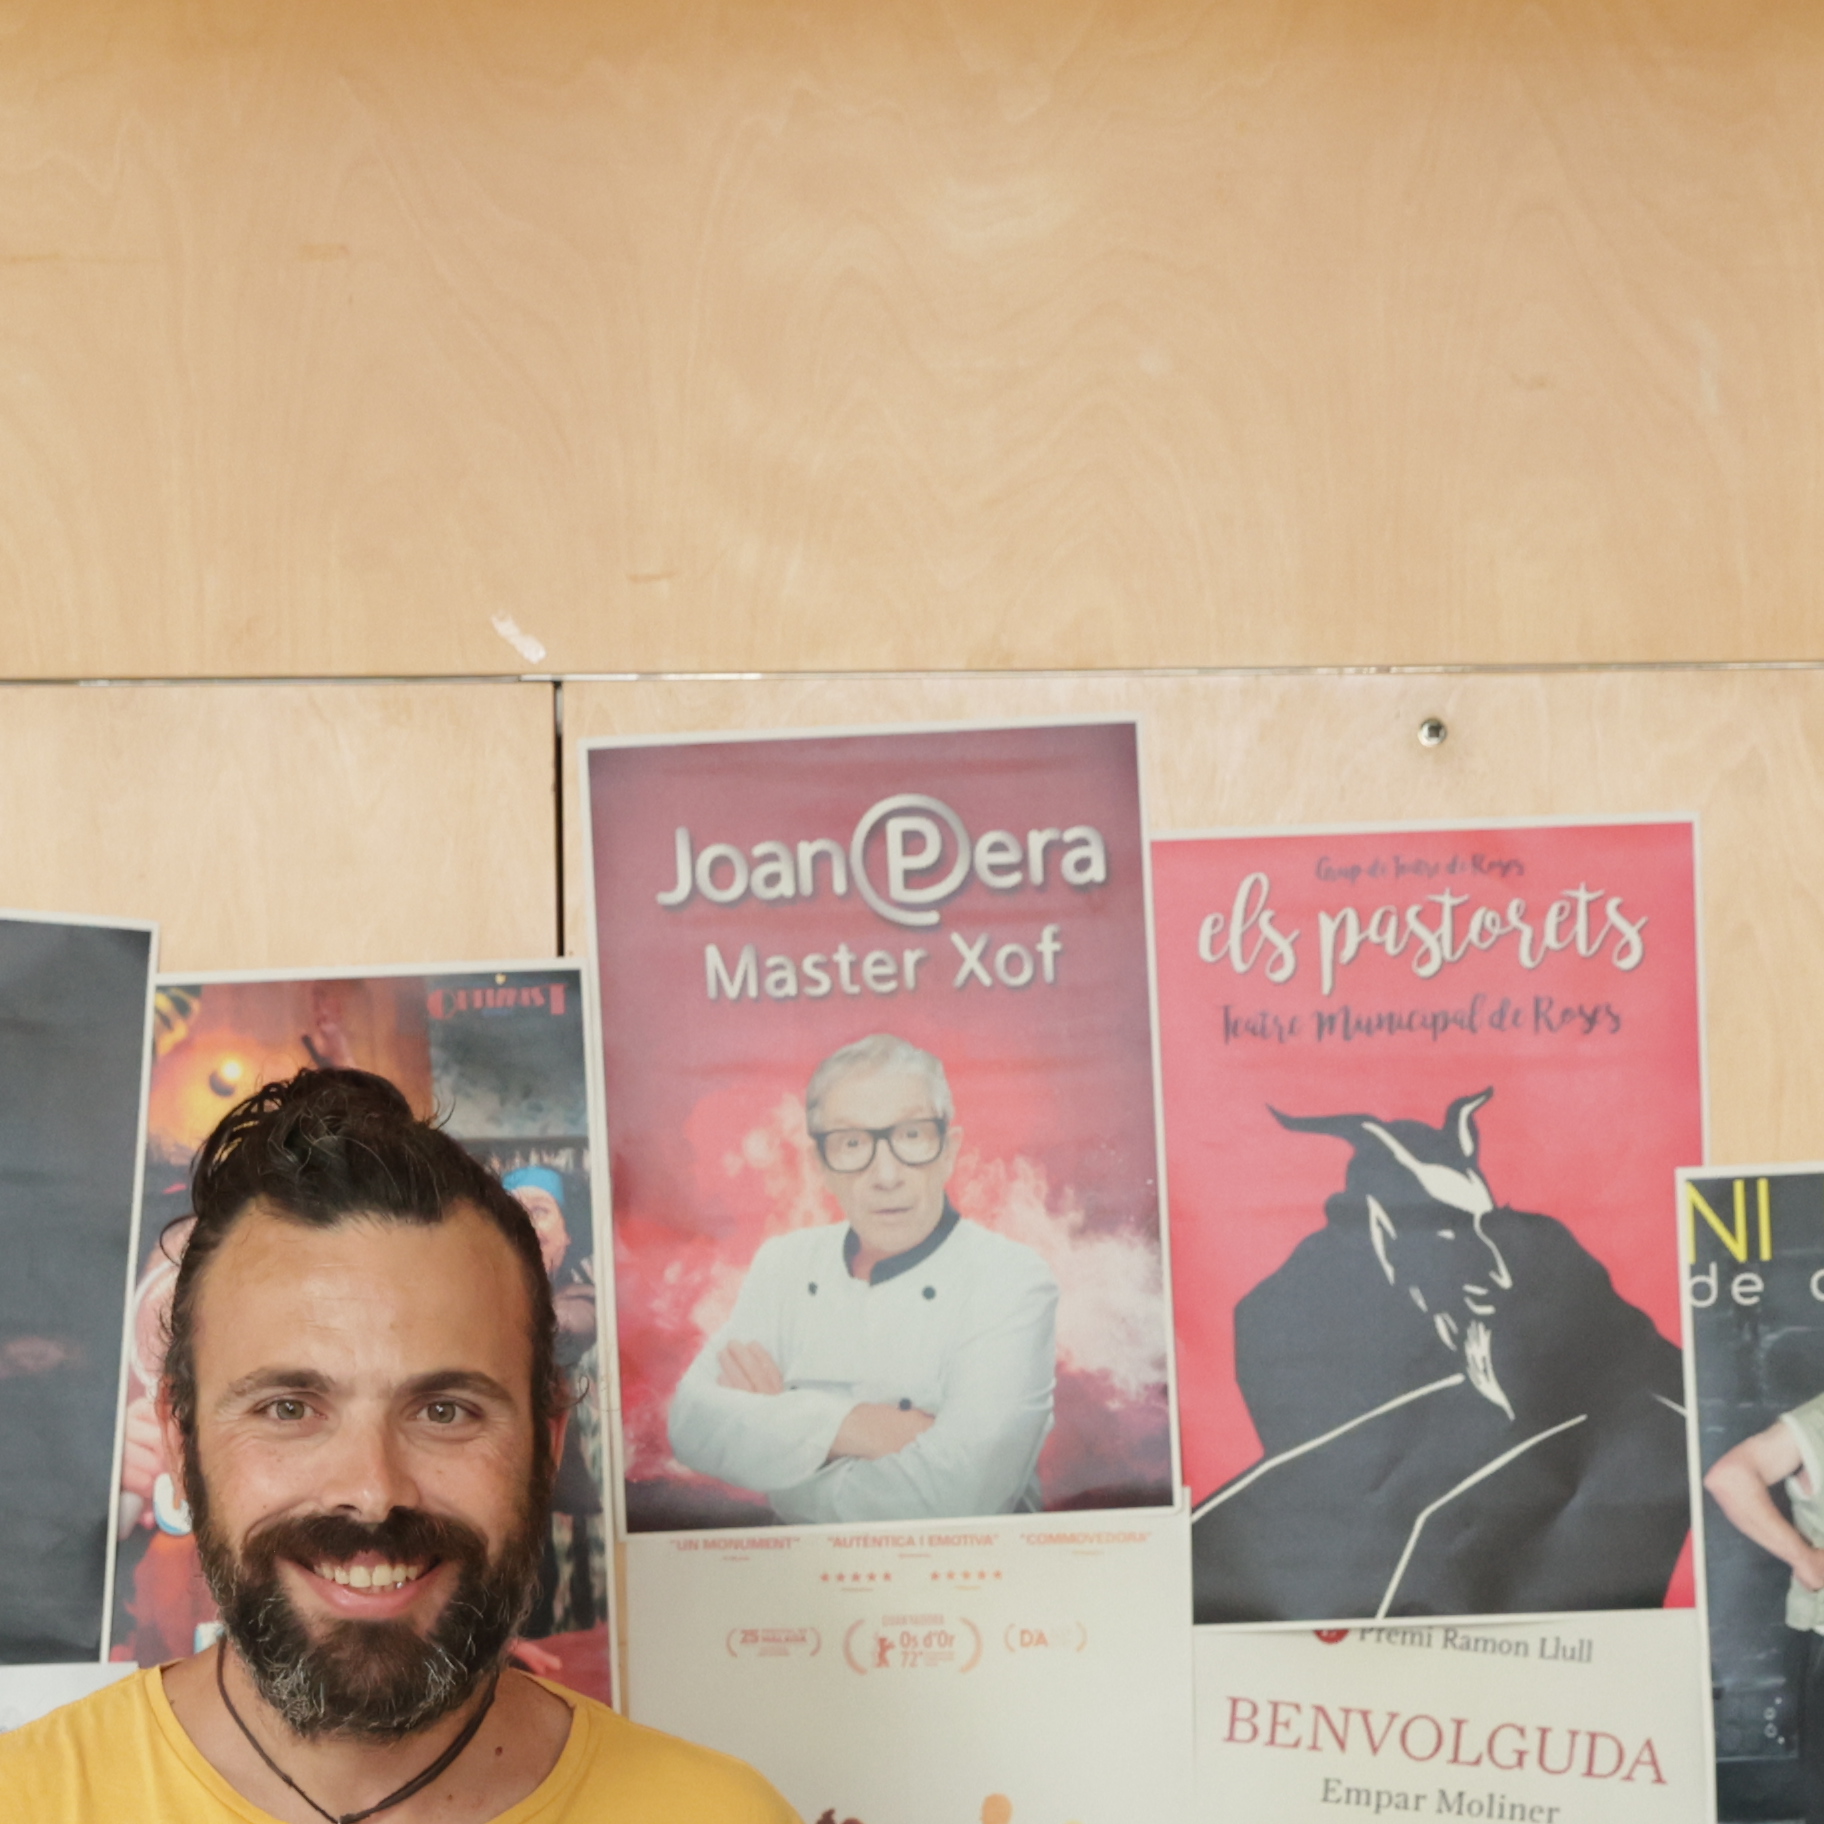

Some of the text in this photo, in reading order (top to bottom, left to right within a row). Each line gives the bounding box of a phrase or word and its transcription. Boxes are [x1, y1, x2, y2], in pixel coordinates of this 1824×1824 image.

[656, 826, 848, 907] Joan
[705, 924, 1063, 1002] Master Xof
[1198, 871, 1648, 996] els pastorets
[1222, 994, 1622, 1045] Teatre Municipal de Roses
[1686, 1178, 1772, 1265] NI
[1689, 1262, 1764, 1308] de
[1442, 1627, 1529, 1658] Ramon
[1539, 1636, 1593, 1663] Llull
[1223, 1696, 1667, 1785] BENVOLGUDA
[1320, 1777, 1561, 1824] Empar Moliner
